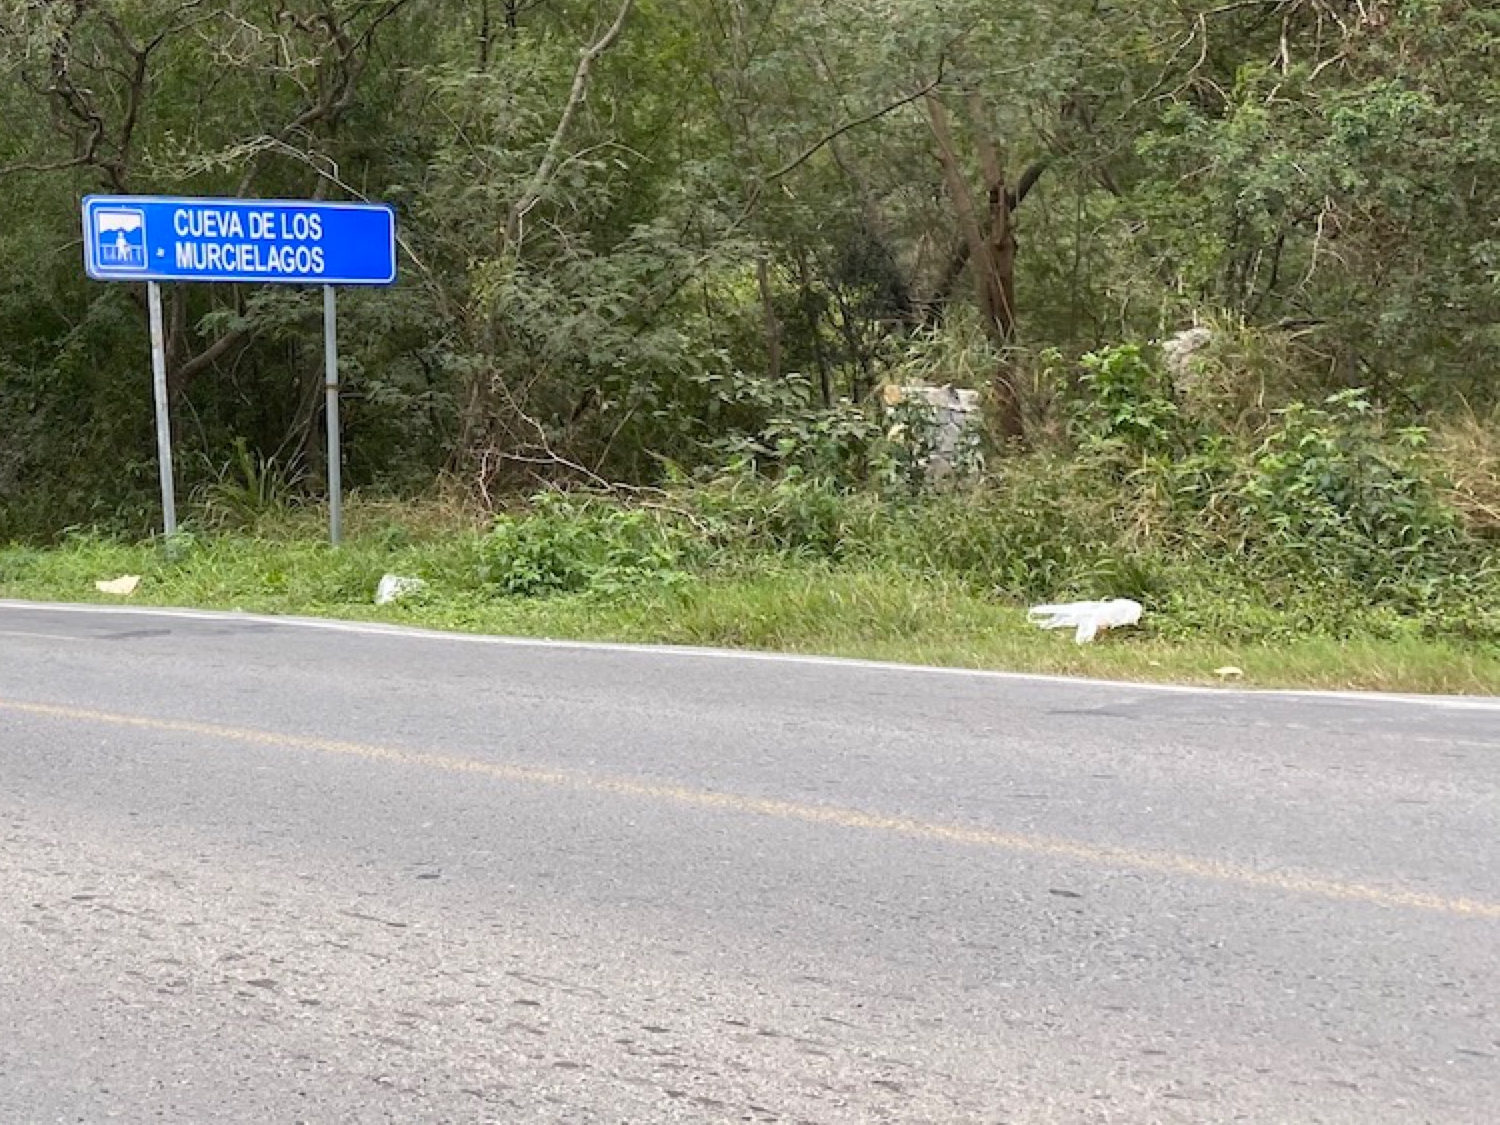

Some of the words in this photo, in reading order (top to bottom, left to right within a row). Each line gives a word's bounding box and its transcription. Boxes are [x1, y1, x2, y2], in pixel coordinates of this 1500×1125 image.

[174, 209, 243, 237] CUEVA
[249, 211, 275, 239] DE
[281, 213, 323, 239] LOS
[175, 241, 325, 273] MURCIELAGOS
